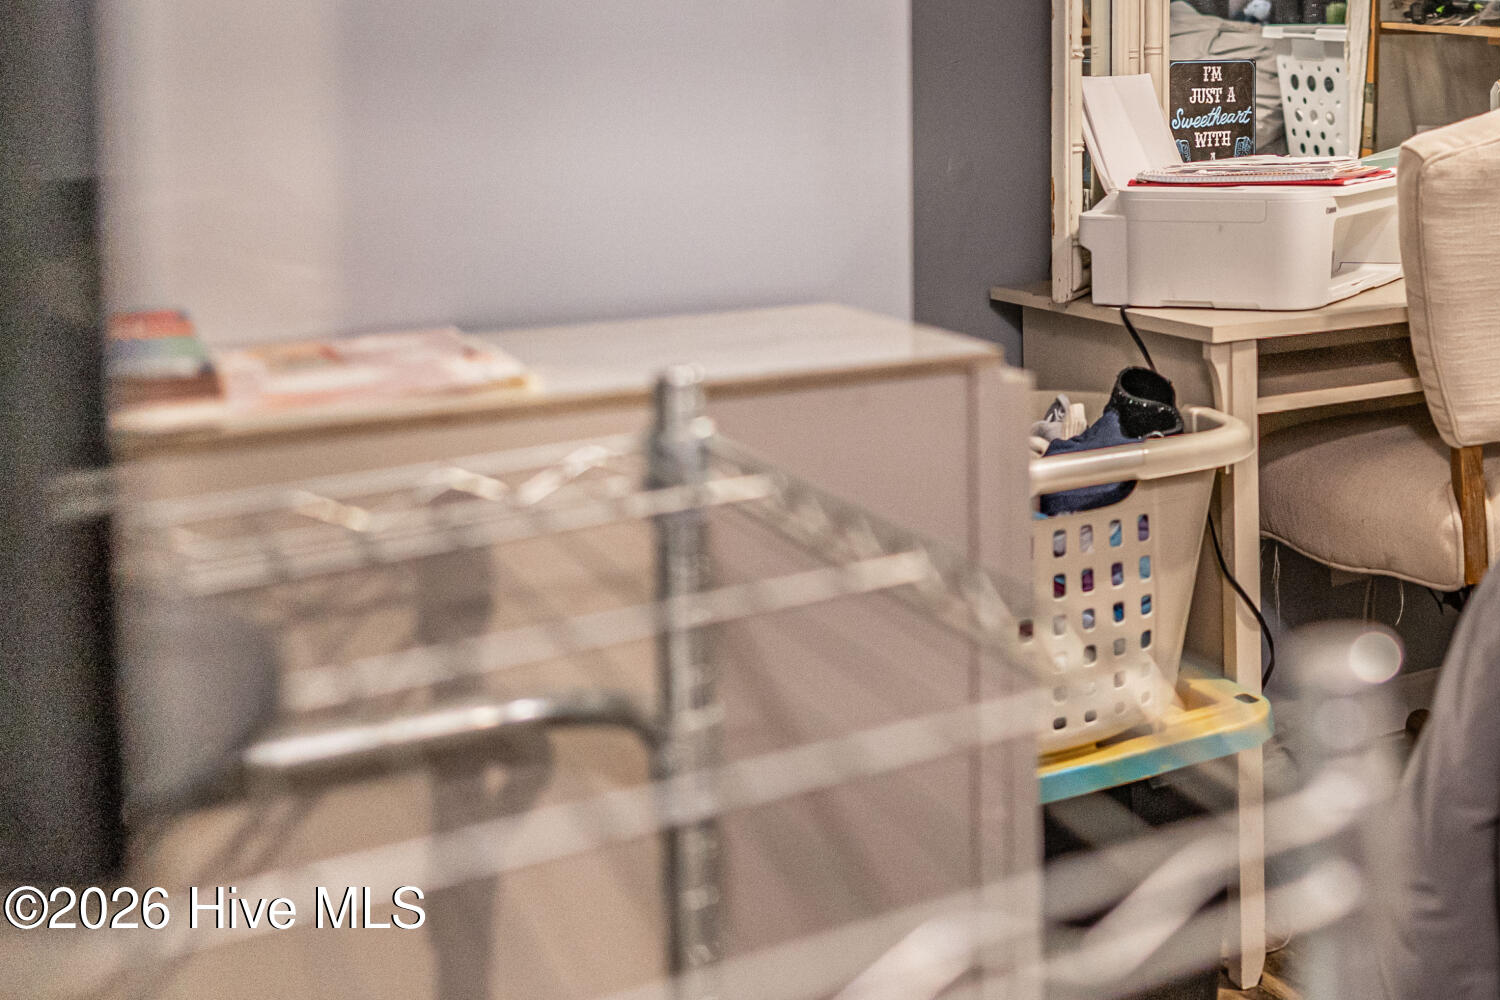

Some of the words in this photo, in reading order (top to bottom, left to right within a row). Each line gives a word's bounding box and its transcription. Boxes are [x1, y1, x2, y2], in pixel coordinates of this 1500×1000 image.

[1203, 66, 1222, 82] I'M
[1189, 87, 1223, 104] JUST
[1226, 86, 1236, 103] A
[1171, 106, 1252, 130] Sweetheart
[1194, 131, 1232, 148] WITH
